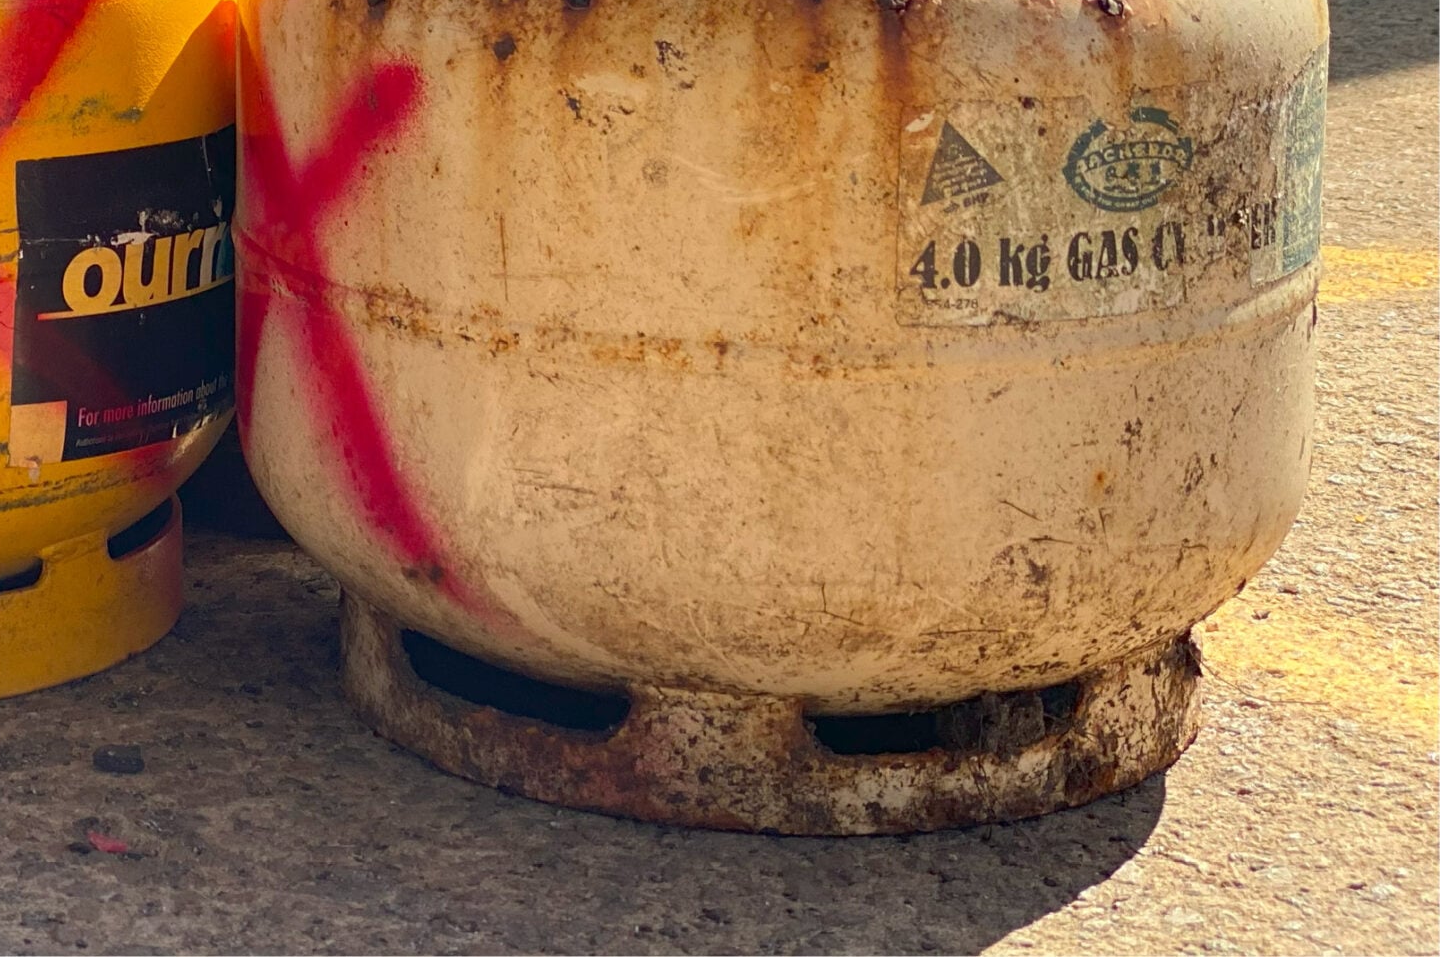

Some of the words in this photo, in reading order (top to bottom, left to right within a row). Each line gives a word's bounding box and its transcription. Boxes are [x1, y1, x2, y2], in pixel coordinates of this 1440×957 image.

[910, 239, 981, 289] 4.0
[999, 233, 1052, 293] kg
[1067, 226, 1140, 282] GAS
[77, 406, 101, 428] For
[103, 403, 135, 424] more
[136, 387, 194, 418] information
